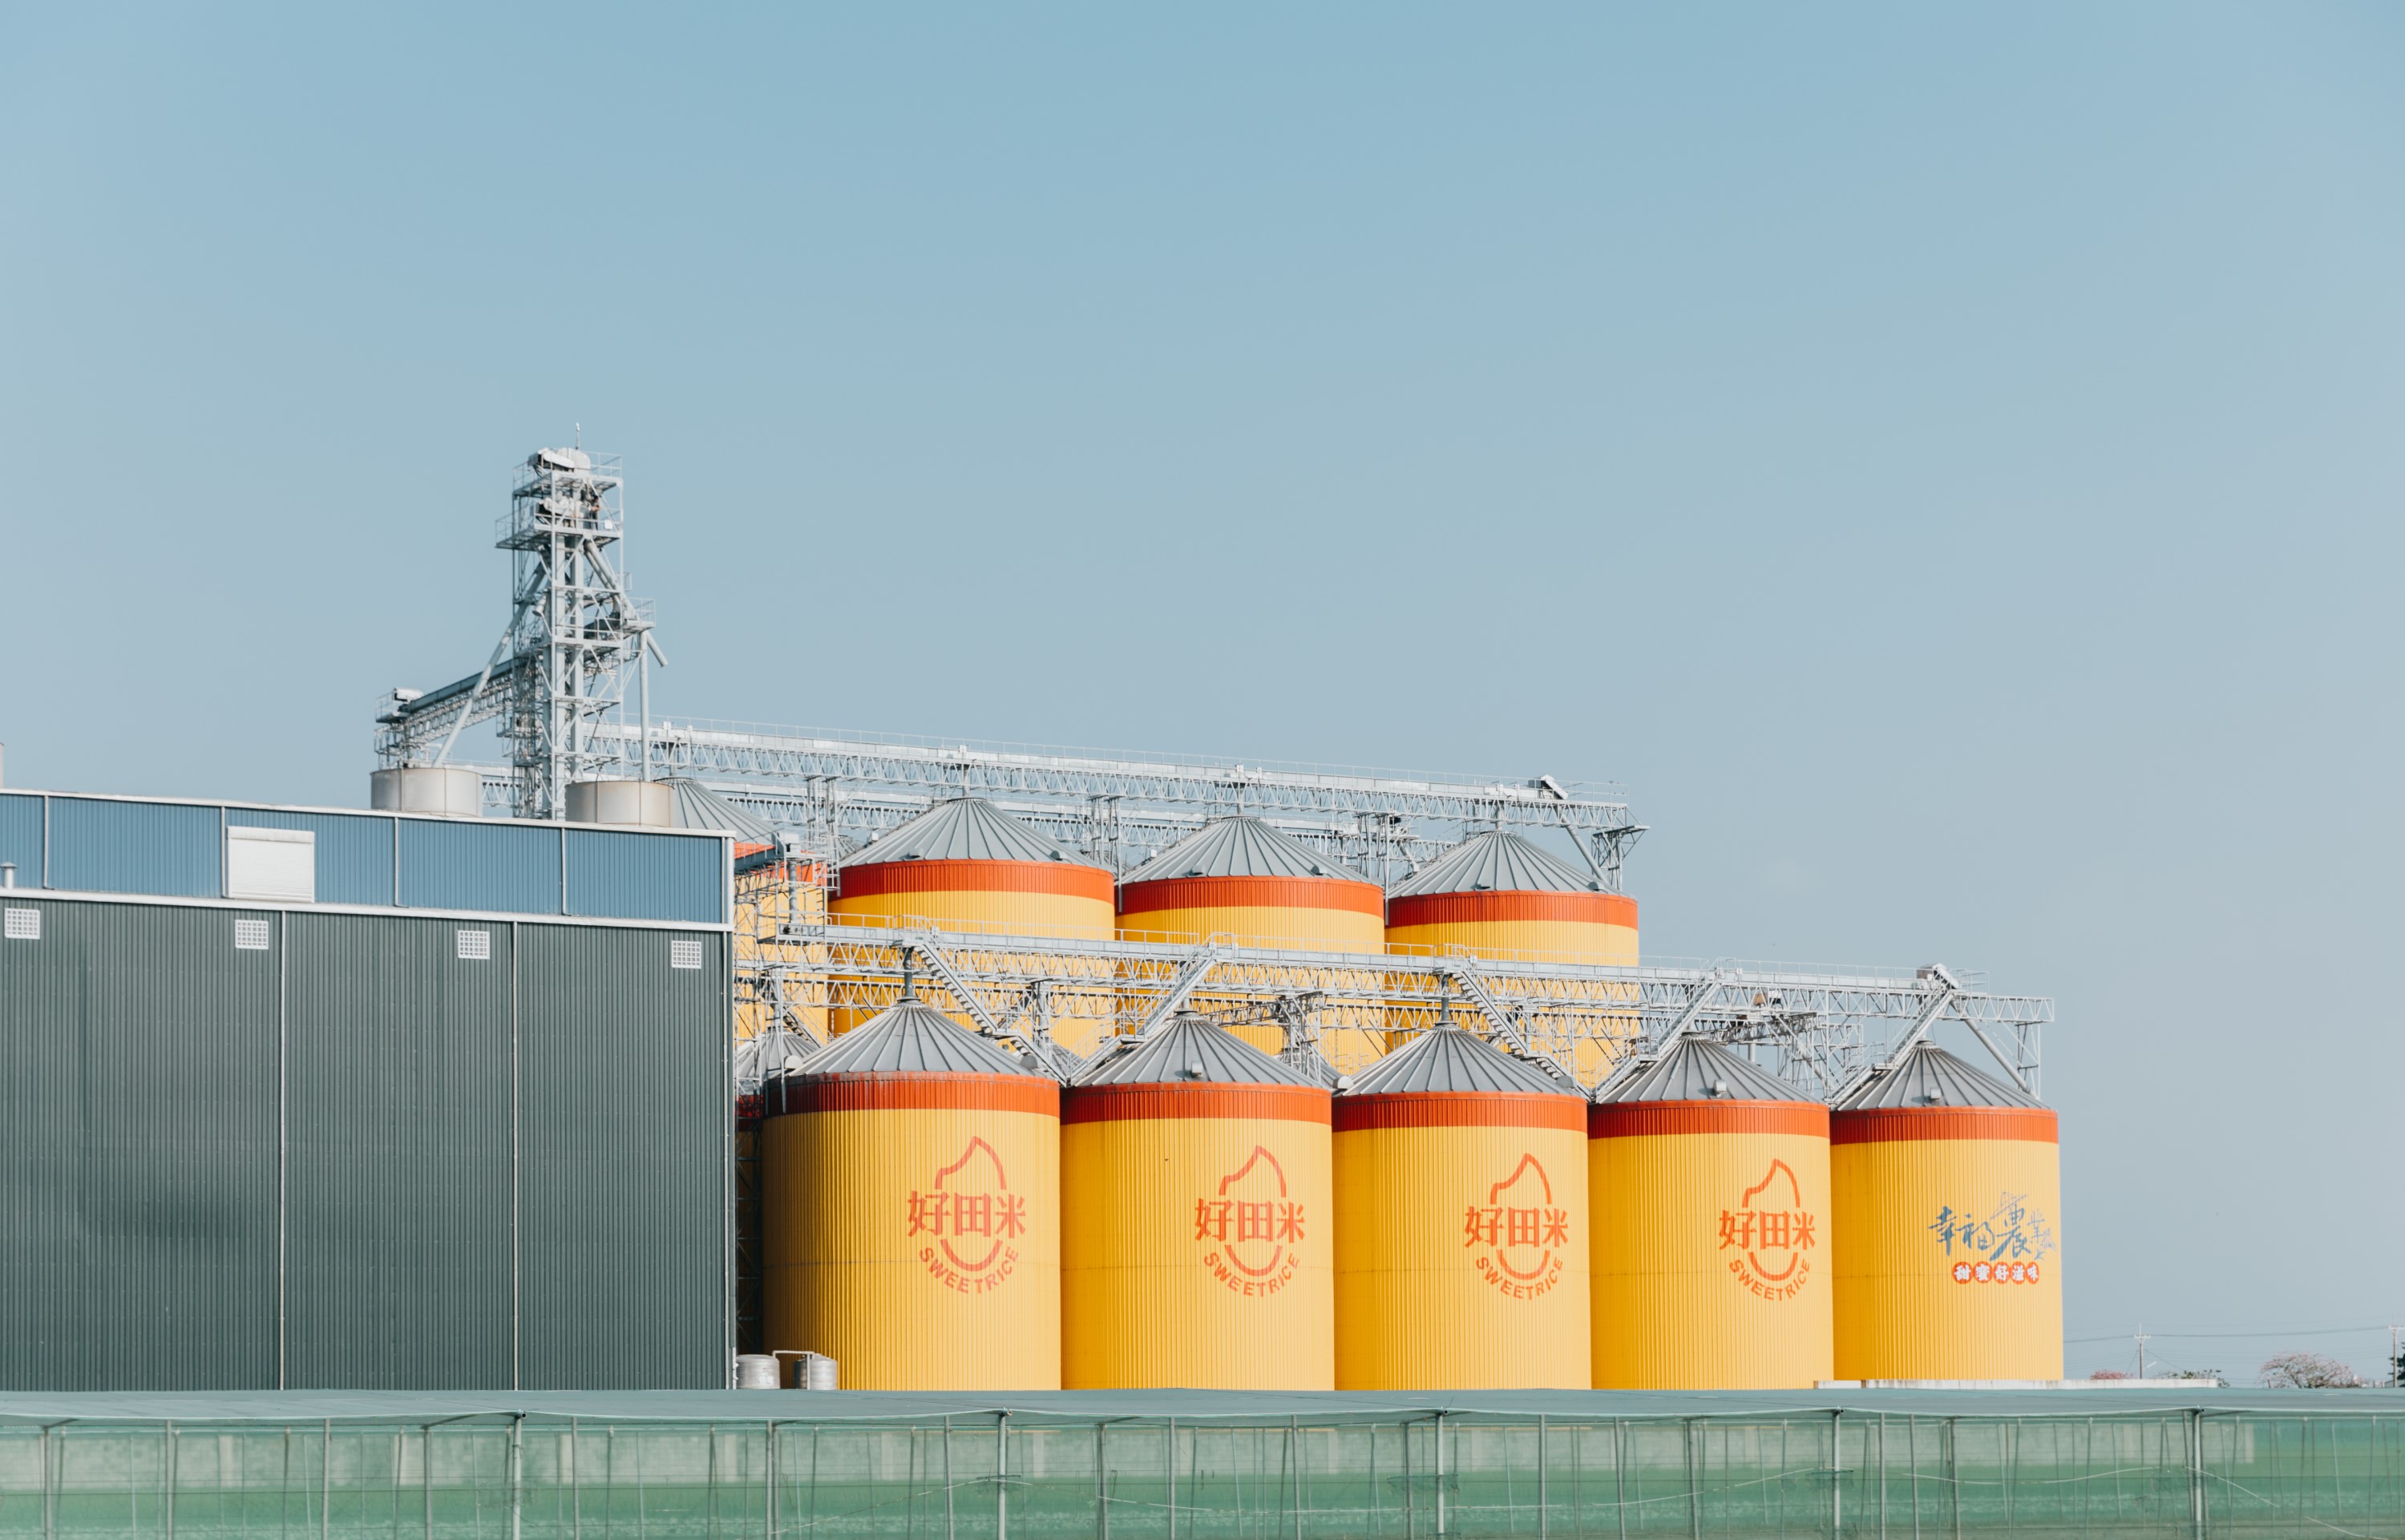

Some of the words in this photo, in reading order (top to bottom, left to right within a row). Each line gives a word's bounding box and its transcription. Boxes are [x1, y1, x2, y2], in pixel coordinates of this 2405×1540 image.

[907, 1190, 1026, 1239] 好田米
[1194, 1198, 1305, 1243] 好田米
[1465, 1206, 1568, 1248] 好田米
[1719, 1209, 1815, 1251] 好田米
[919, 1247, 1019, 1294] SWEETRICE
[1204, 1251, 1300, 1297] SWEETRICE
[1476, 1256, 1563, 1300] SWEETRICE
[1729, 1259, 1810, 1301] SWEETRICE
